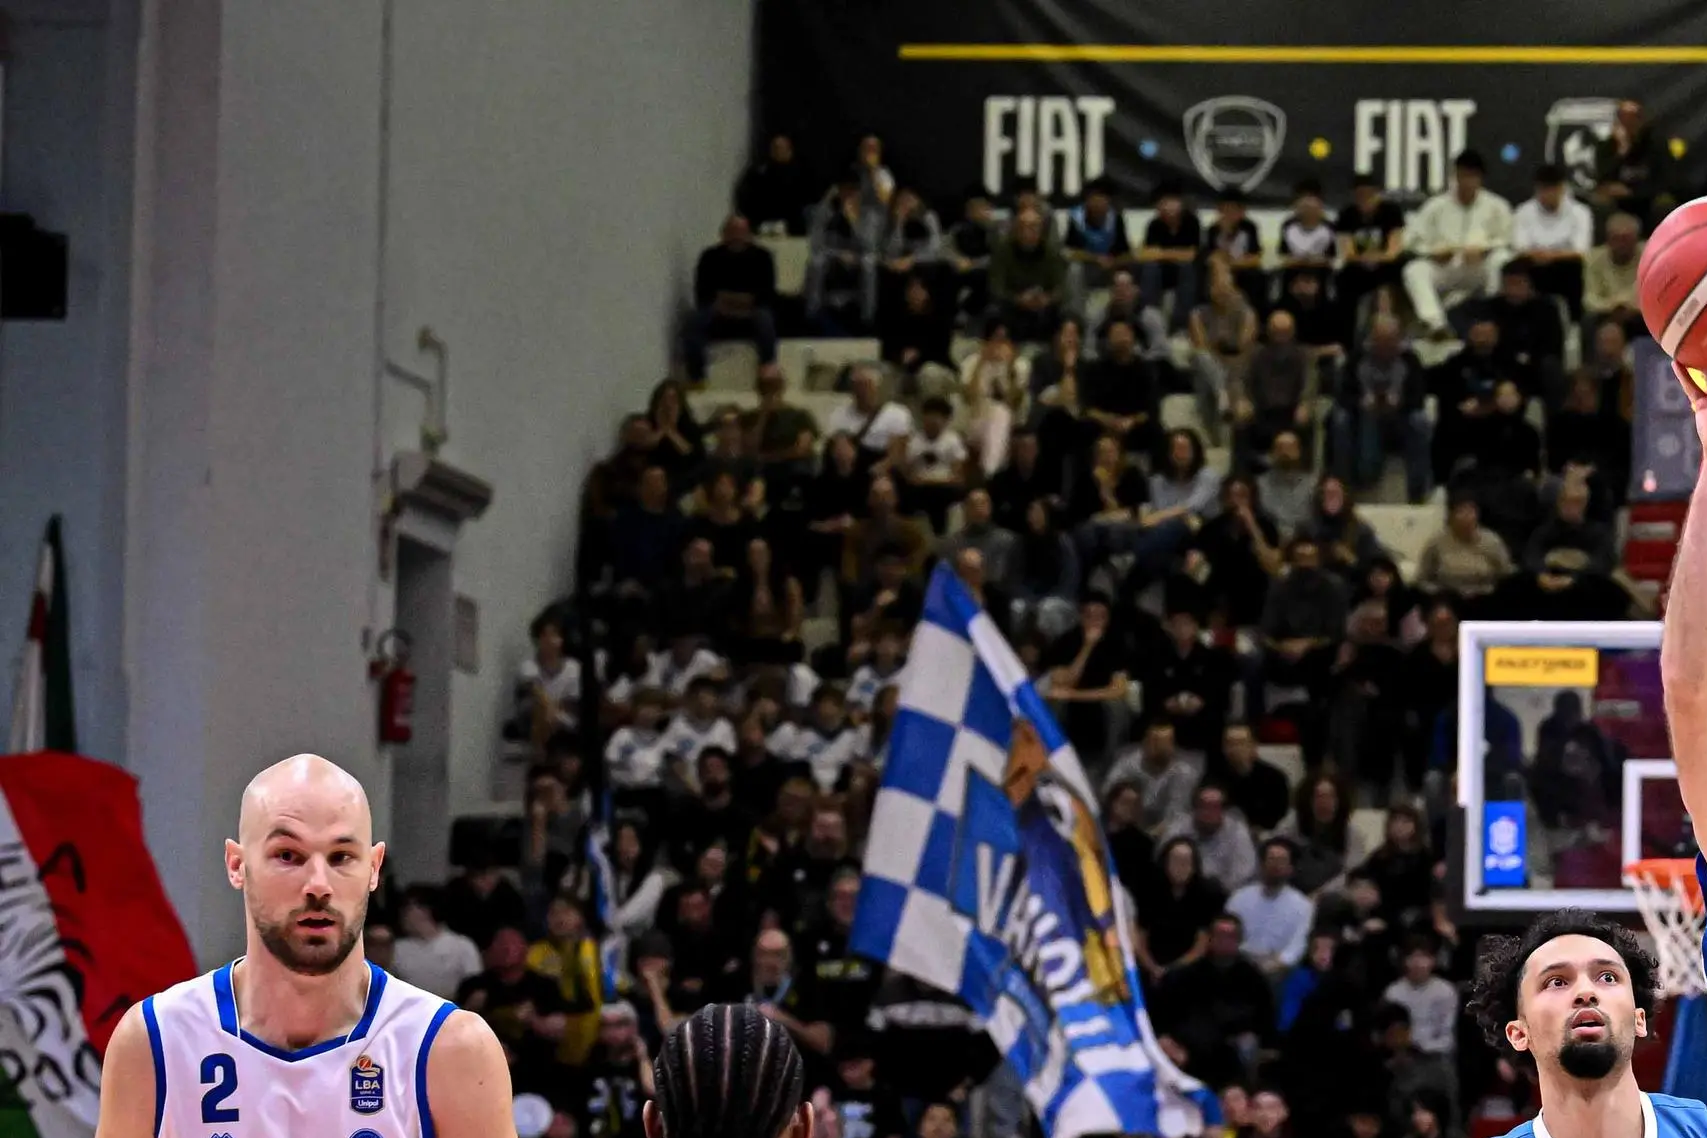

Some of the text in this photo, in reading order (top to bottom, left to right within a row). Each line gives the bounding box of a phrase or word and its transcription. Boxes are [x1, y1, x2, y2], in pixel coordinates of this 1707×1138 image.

[984, 94, 1116, 197] FIAT
[1355, 98, 1477, 192] FIAT
[200, 1053, 240, 1123] 2
[355, 1080, 380, 1090] LBA
[358, 1099, 379, 1108] Unipol
